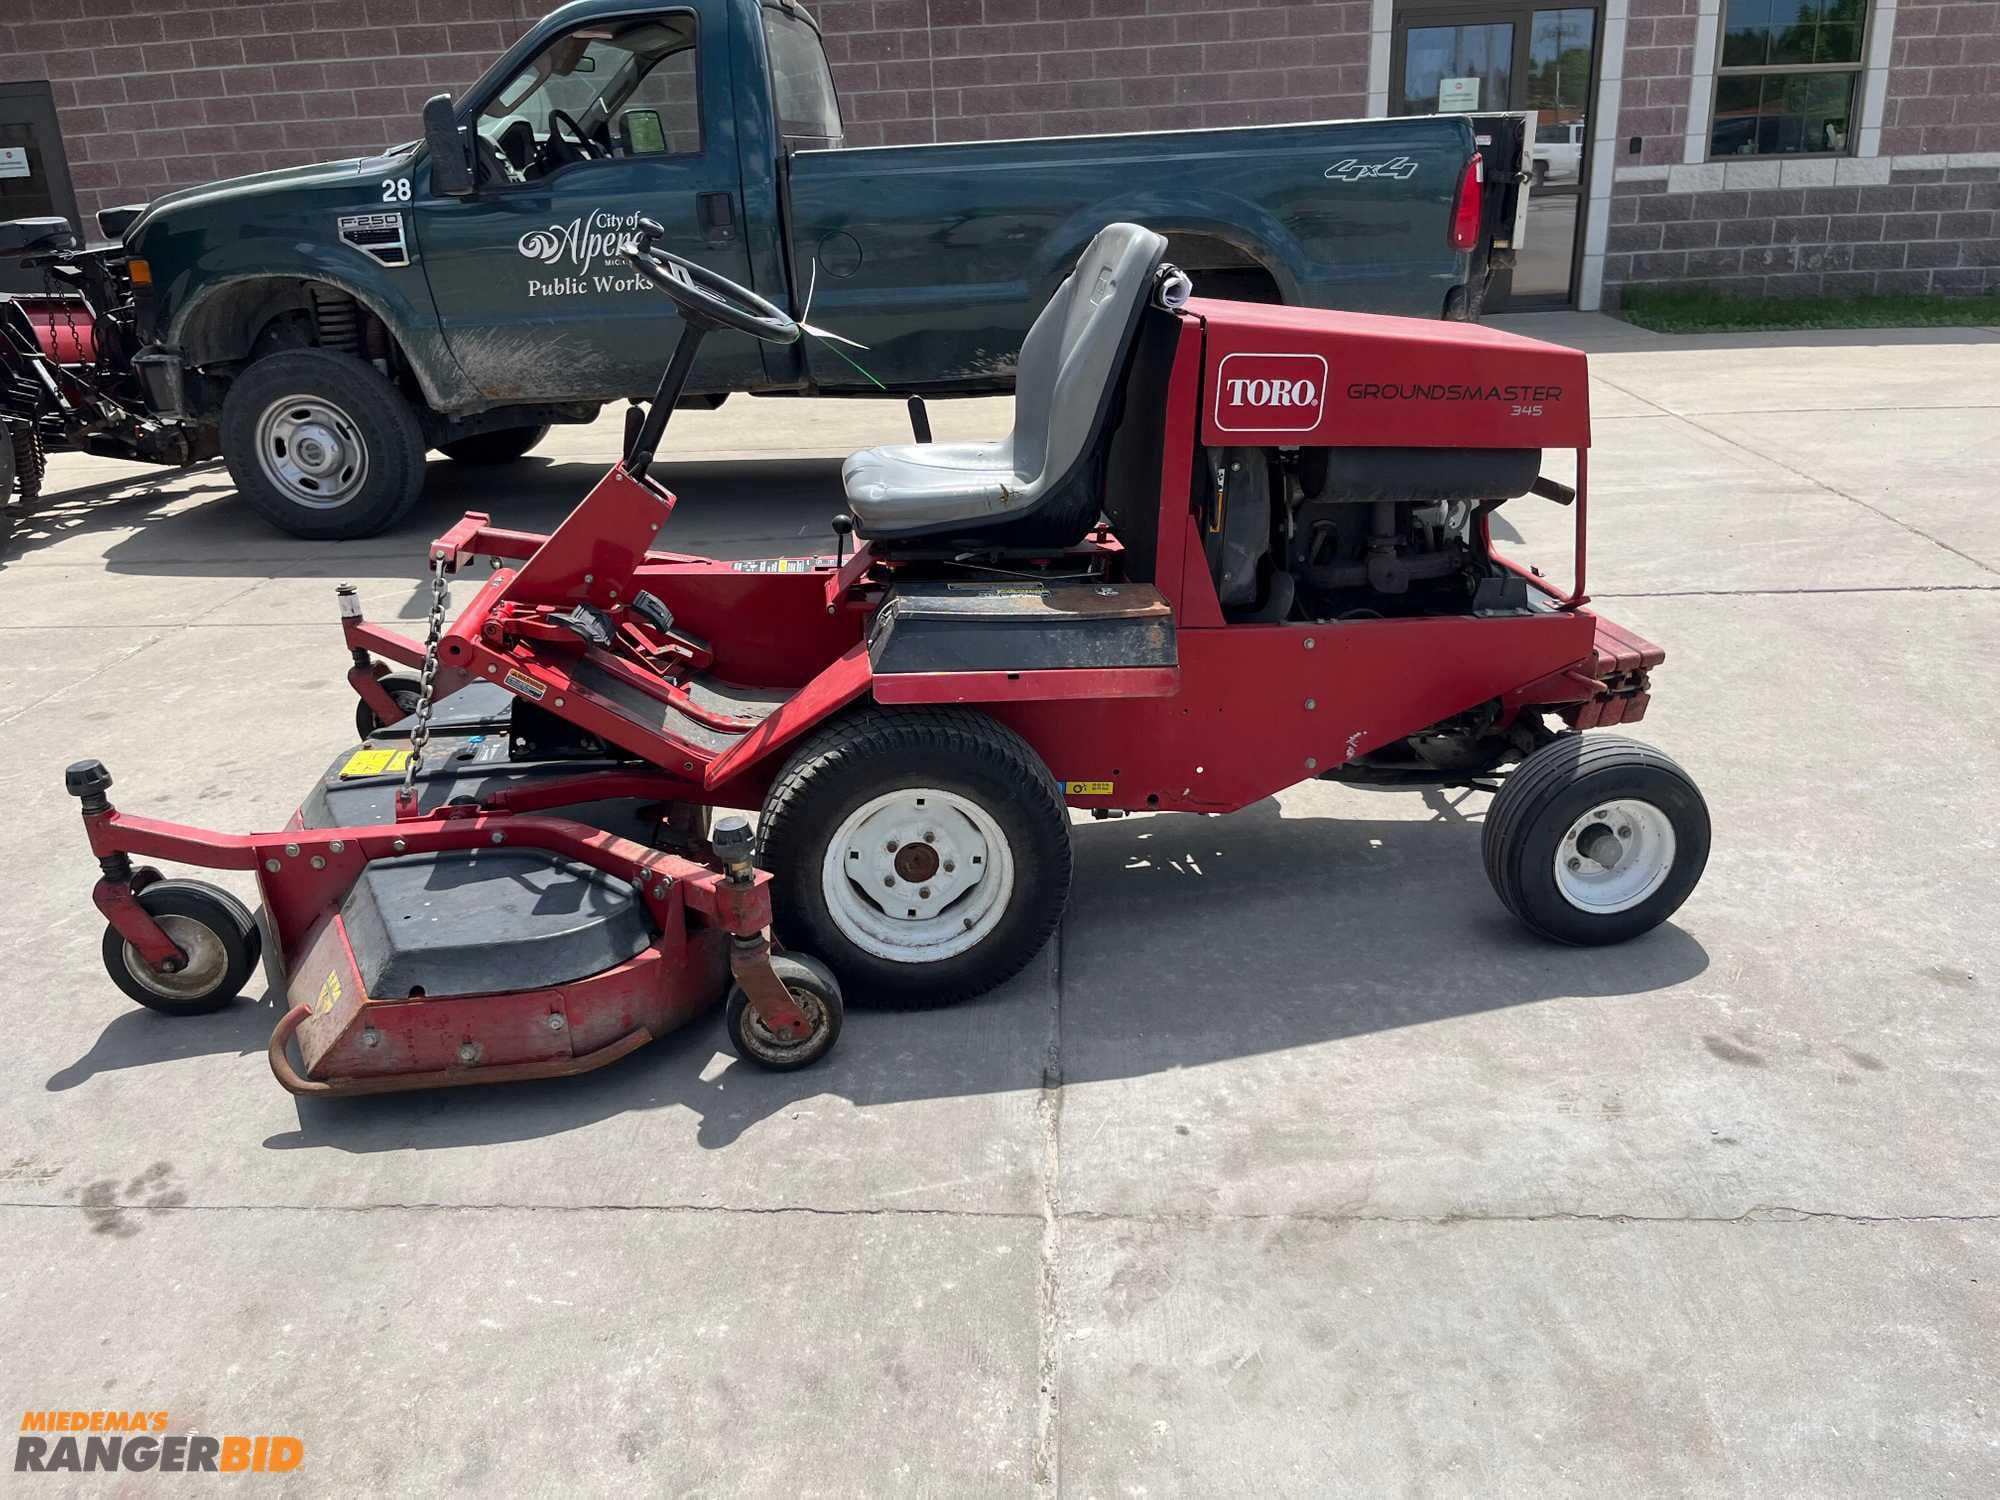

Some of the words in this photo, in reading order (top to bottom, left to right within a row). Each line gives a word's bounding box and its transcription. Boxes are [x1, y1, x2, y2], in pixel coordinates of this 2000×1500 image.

[1324, 156, 1419, 182] 4x4
[382, 178, 412, 202] 28
[596, 212, 624, 232] City
[626, 210, 641, 231] of
[528, 277, 588, 297] Public
[592, 273, 654, 294] Works
[1226, 379, 1316, 407] TORO
[1347, 383, 1563, 402] GROUNDSMASTER
[1510, 405, 1543, 417] 345
